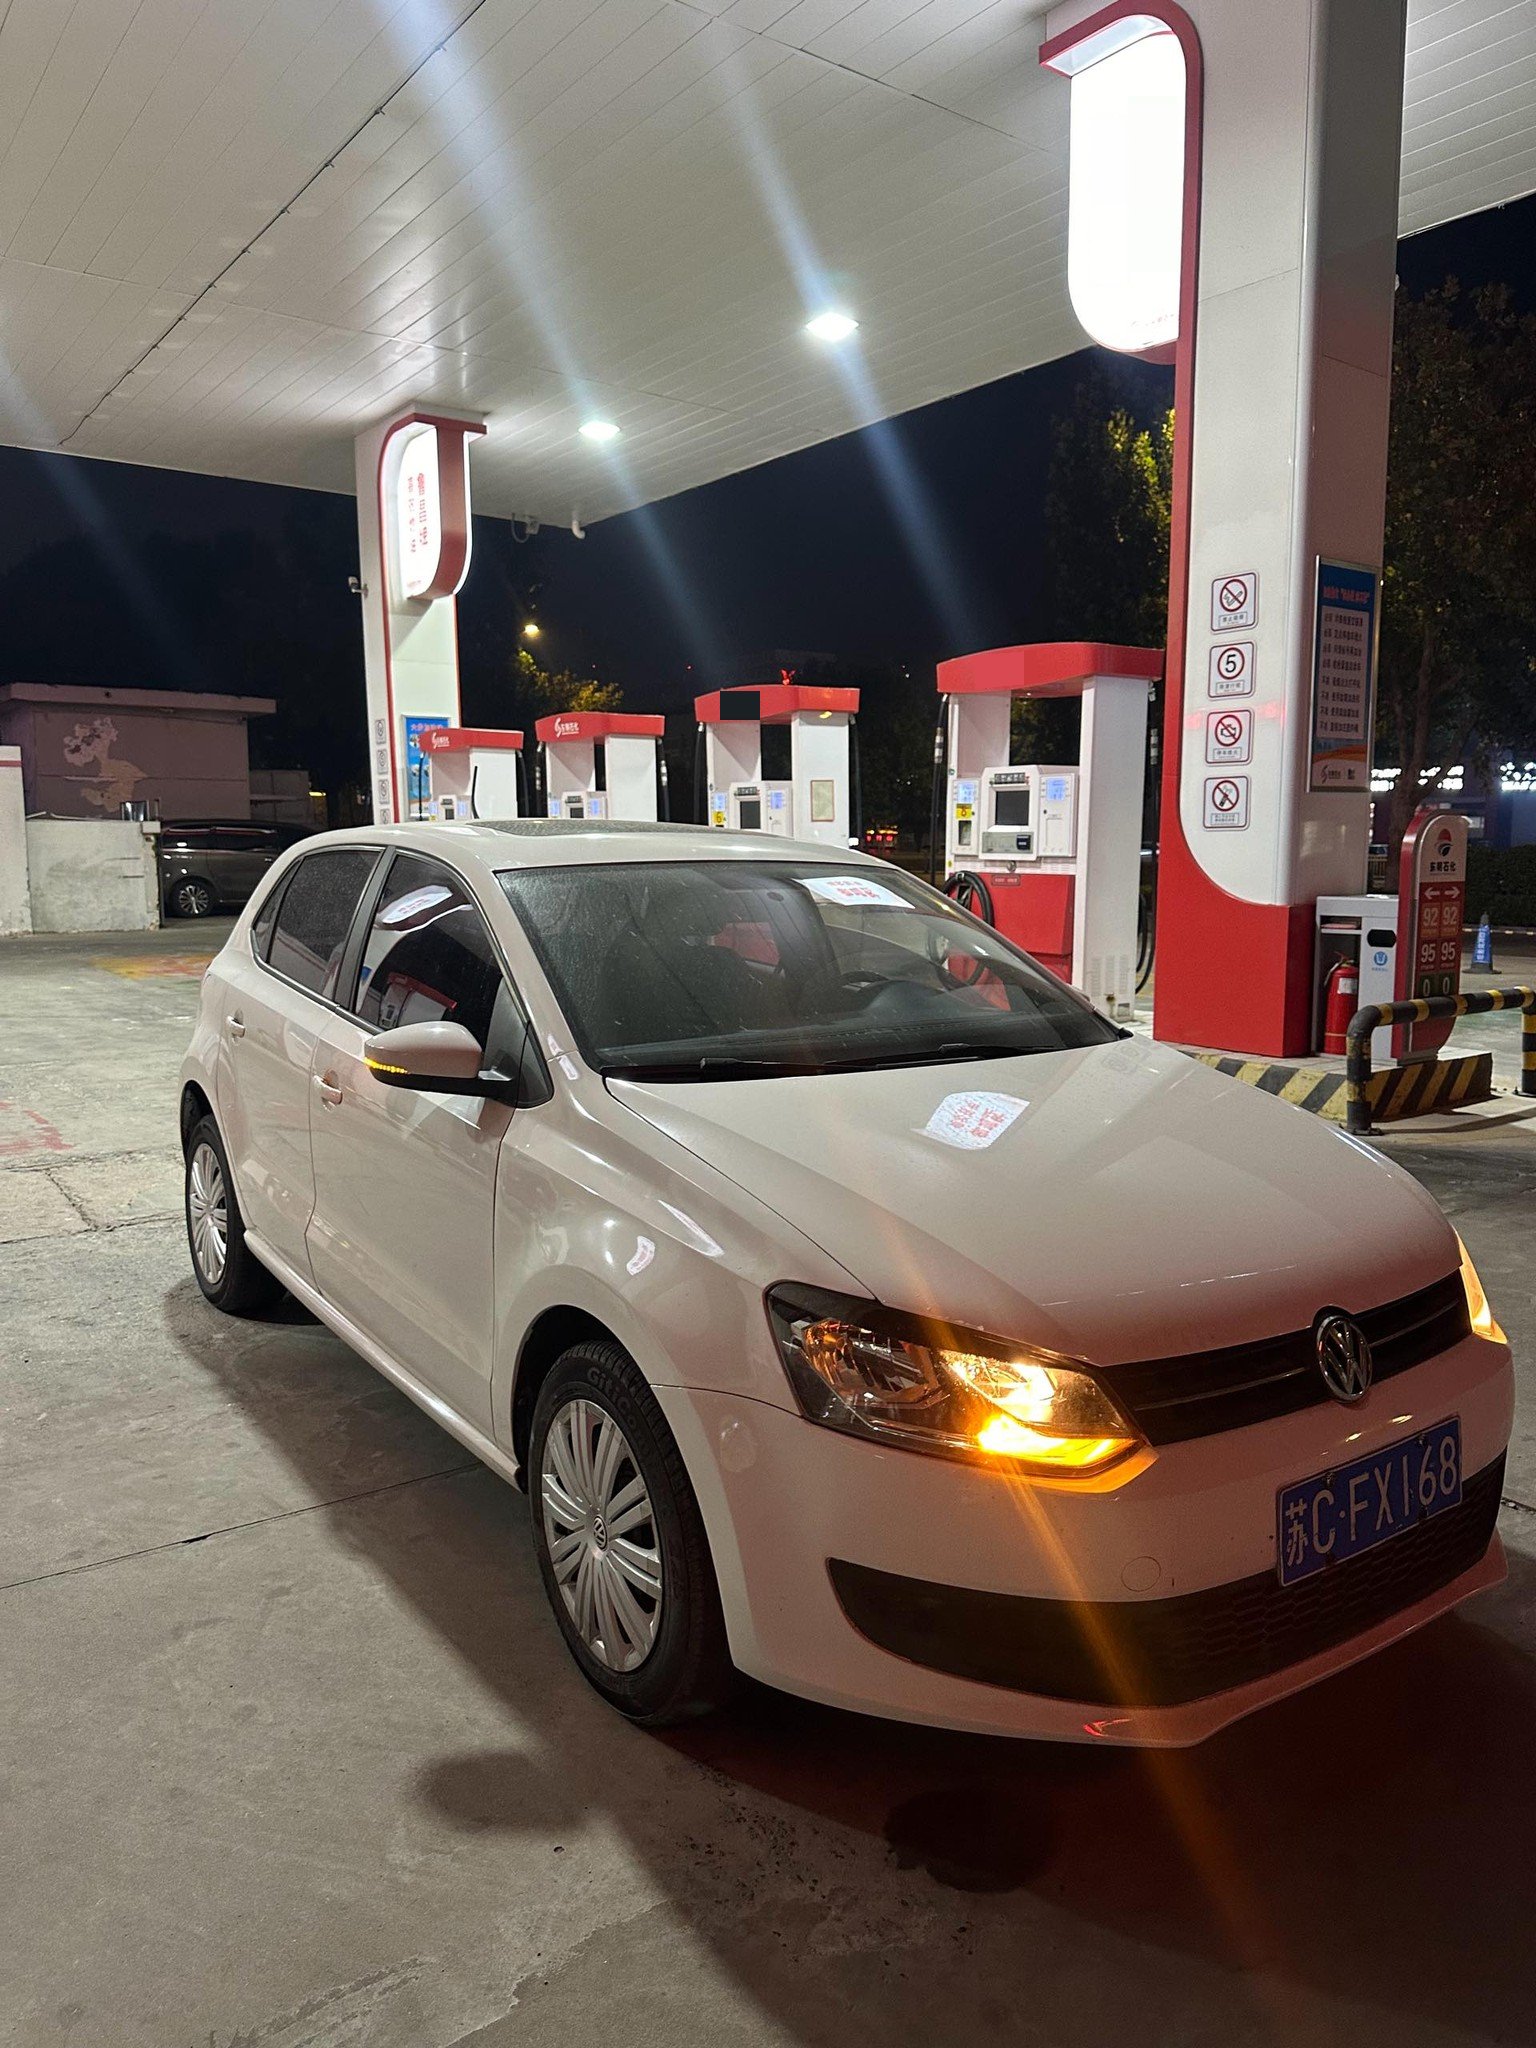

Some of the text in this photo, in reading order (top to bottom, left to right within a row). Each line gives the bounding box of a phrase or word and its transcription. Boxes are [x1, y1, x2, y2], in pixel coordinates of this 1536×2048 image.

[1225, 654, 1237, 673] 5
[1422, 906, 1458, 927] 92 92
[1421, 943, 1436, 963] 95
[1441, 941, 1456, 961] 95
[1422, 977, 1450, 997] 0 0
